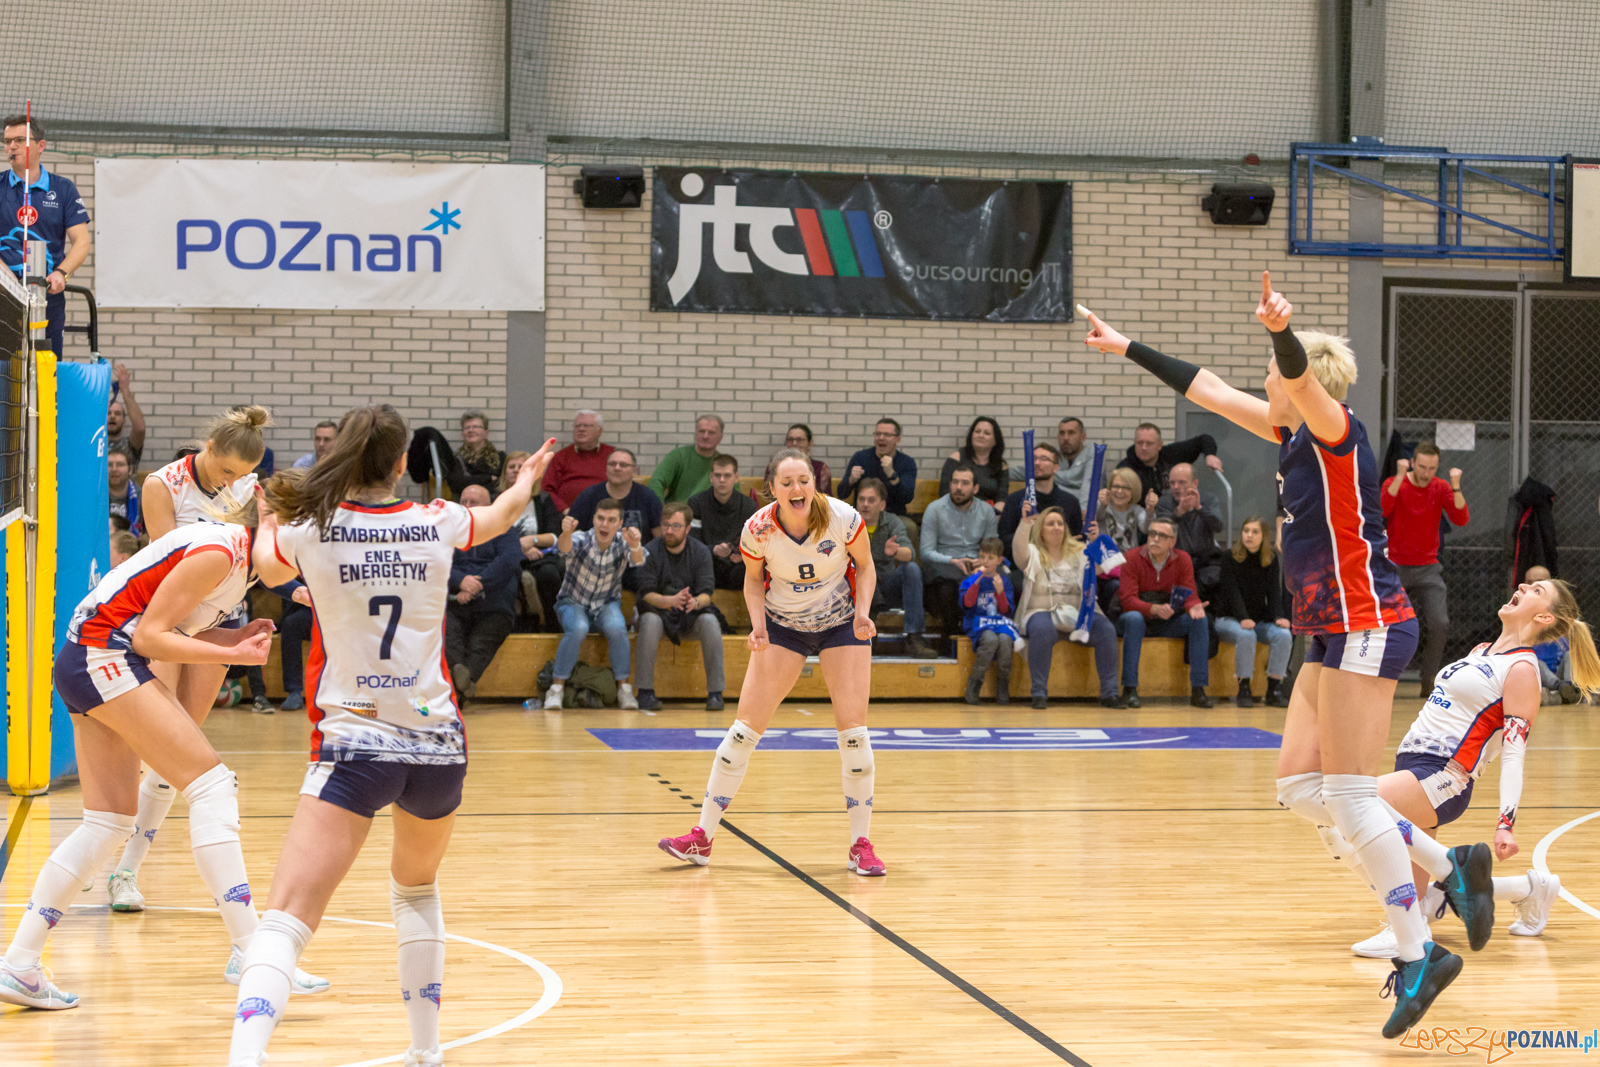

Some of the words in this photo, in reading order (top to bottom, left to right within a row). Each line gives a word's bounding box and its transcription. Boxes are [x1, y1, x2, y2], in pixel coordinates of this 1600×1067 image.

[667, 173, 809, 306] jtc
[365, 550, 402, 563] ENEA
[339, 563, 427, 584] ENERGETYK
[798, 563, 815, 579] 8
[368, 595, 402, 660] 7
[98, 662, 122, 681] 11
[1442, 661, 1470, 680] 9
